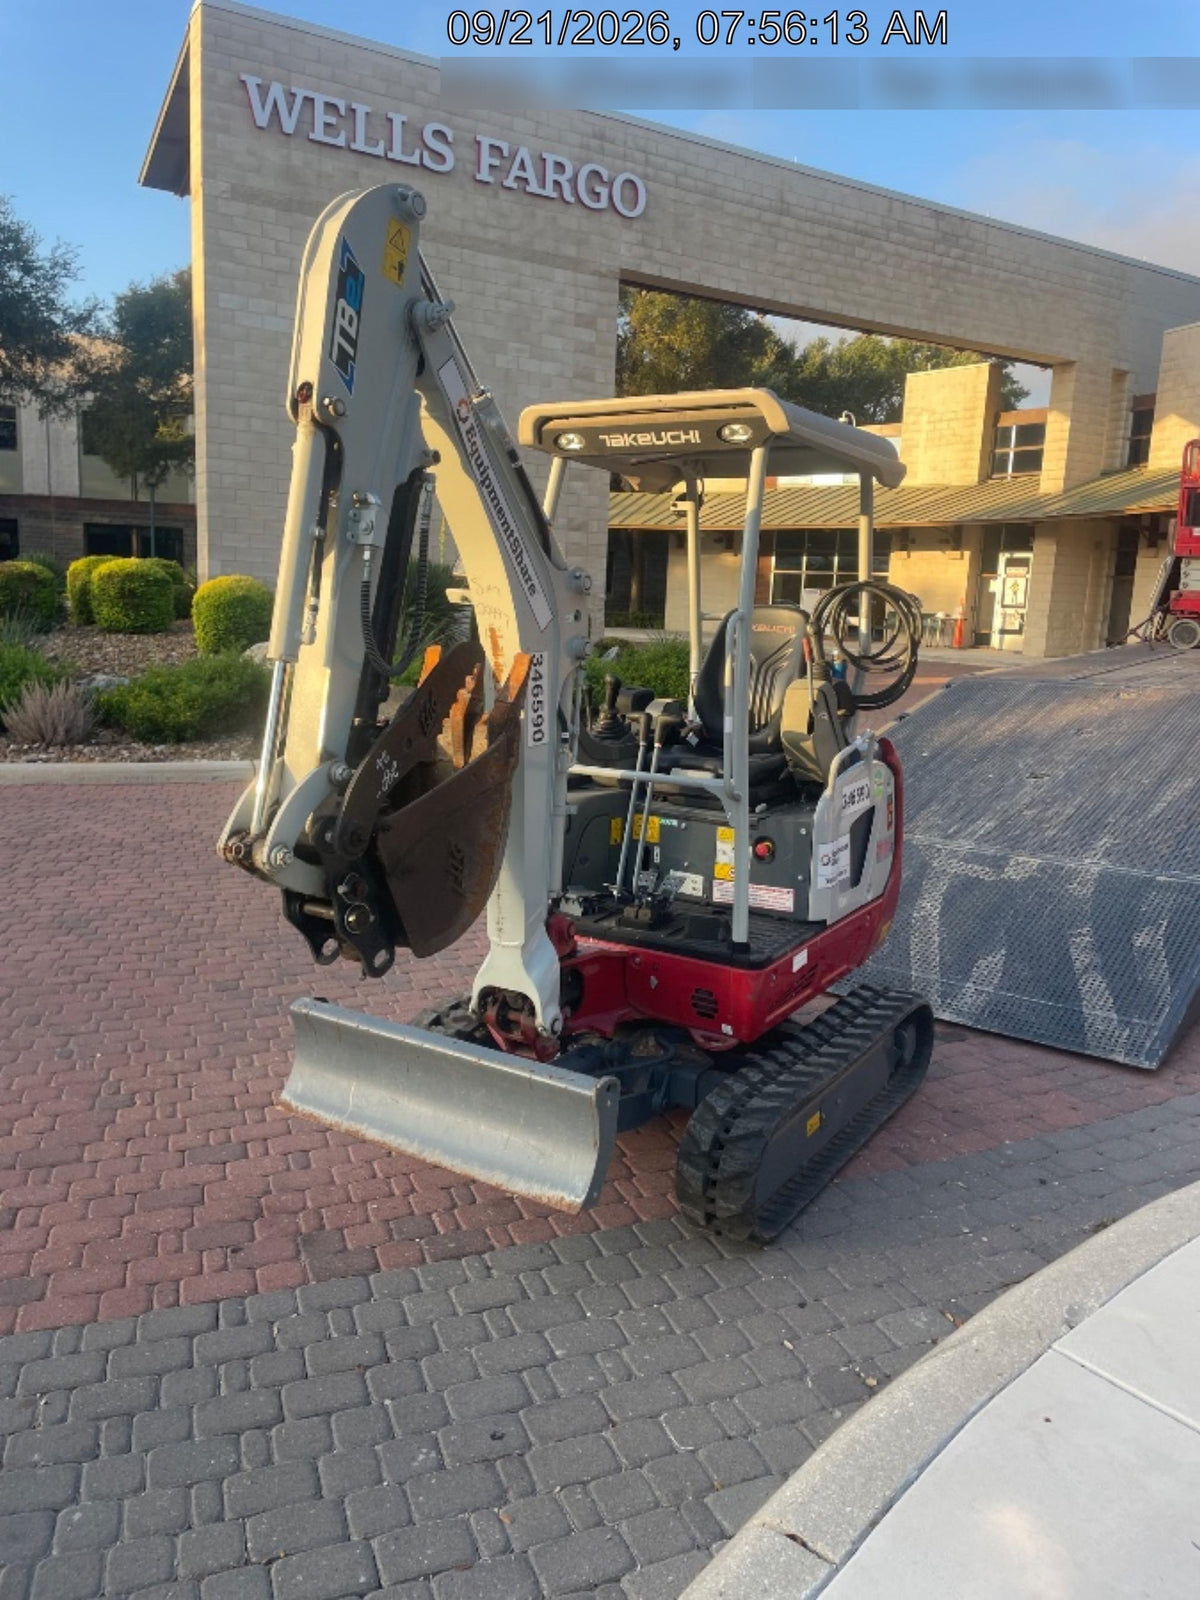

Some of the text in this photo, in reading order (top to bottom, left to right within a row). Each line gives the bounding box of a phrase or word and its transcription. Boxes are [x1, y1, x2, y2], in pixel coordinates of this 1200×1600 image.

[240, 73, 648, 219] WELLS FARGO
[463, 418, 537, 598] EquipmentShare
[530, 653, 545, 743] 346590
